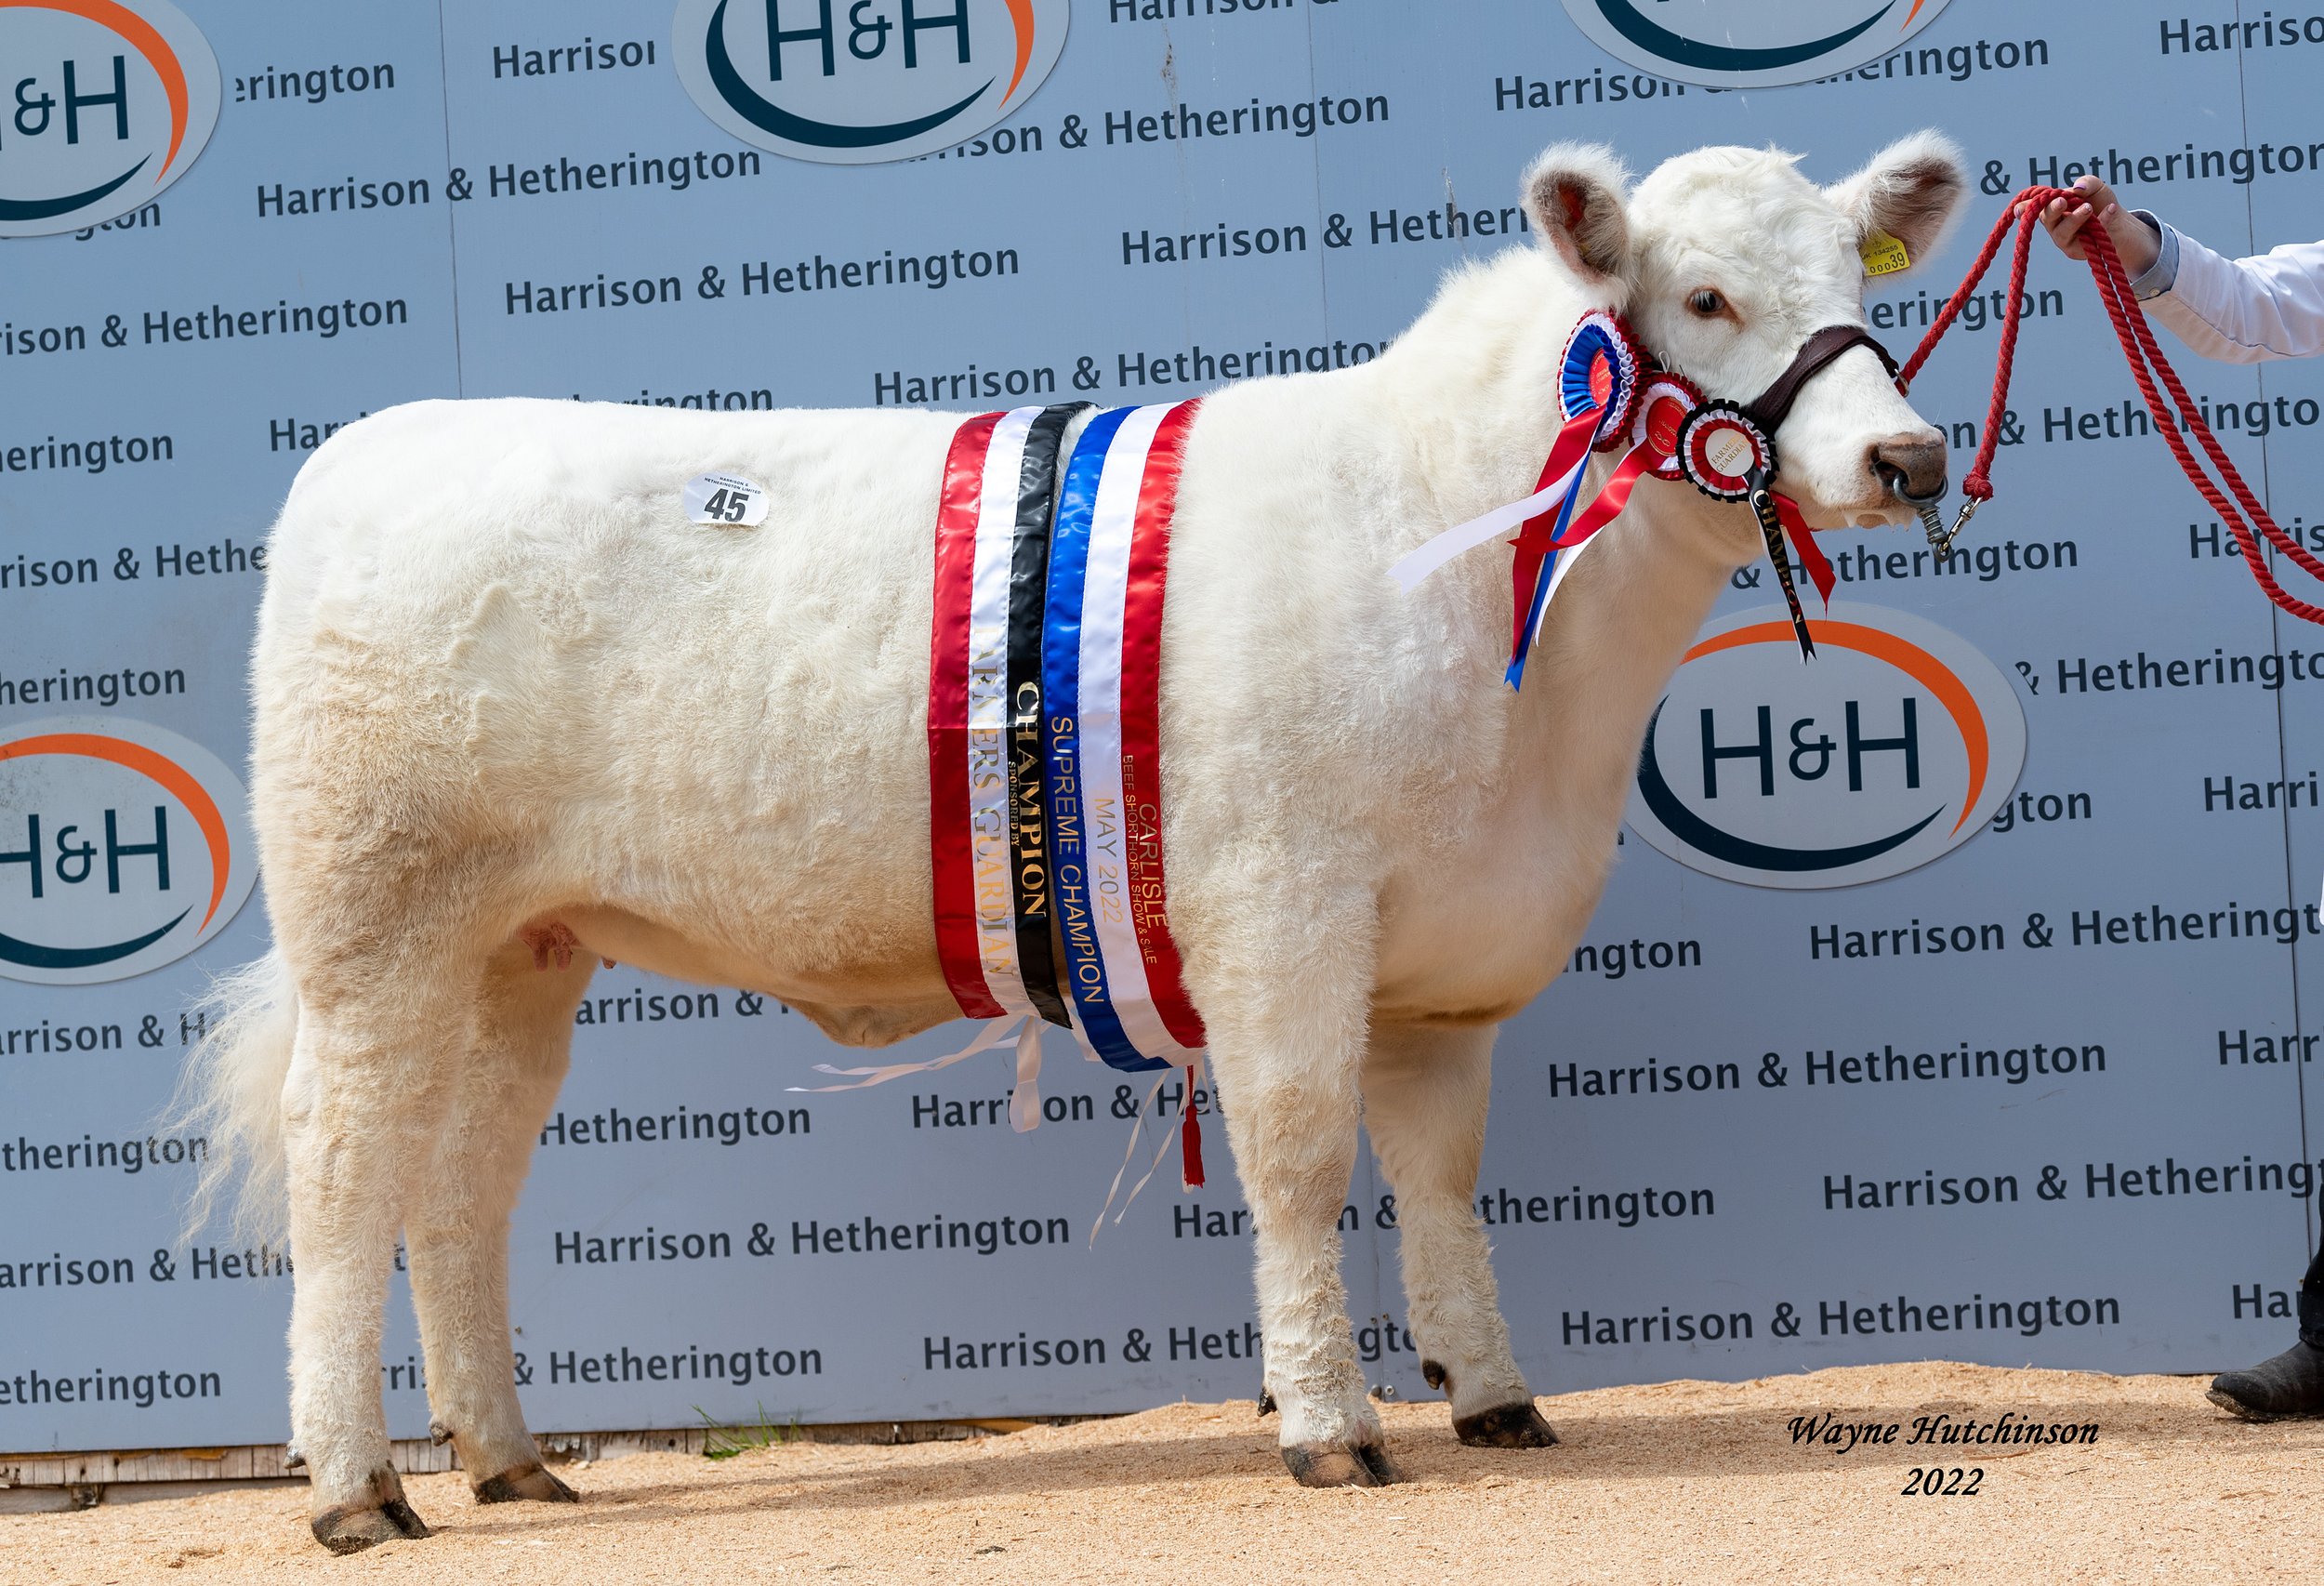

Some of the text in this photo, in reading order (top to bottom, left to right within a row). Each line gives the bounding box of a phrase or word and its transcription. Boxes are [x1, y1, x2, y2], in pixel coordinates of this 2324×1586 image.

[766, 0, 971, 82] H&H
[1059, 115, 1088, 148] &
[1105, 96, 1388, 144] Hetherington
[258, 152, 759, 217] Harrison & Hetherington
[1981, 160, 2011, 199] &
[1123, 226, 1305, 264] Harrison
[1324, 214, 1352, 247] &
[507, 247, 1018, 314] Harrison & Hetherington
[0, 298, 407, 357] ison & Hetherington
[875, 368, 1054, 404] Harrison
[1073, 356, 1101, 390] &
[704, 477, 761, 495] HETHERINGTON LIMITED
[704, 488, 749, 522] 45
[720, 477, 745, 486] HARRISON
[113, 548, 140, 580] &
[1753, 489, 1804, 624] CHAMPION
[1700, 697, 1921, 799] H&H
[1008, 761, 1021, 847] SPONSORED BY
[1015, 681, 1047, 918] CHAMPION
[1050, 716, 1104, 1003] SUPREME CHAMPION
[1093, 798, 1123, 924] MAY 2022
[1123, 755, 1157, 965] BEEF SHORTHORN SHOW & SALE
[1138, 803, 1169, 929] CARLISLE
[974, 806, 1014, 977] GUARDIAN
[1811, 922, 2005, 959] Harrison
[2023, 913, 2053, 948] &
[735, 989, 763, 1017] &
[0, 1019, 122, 1056] rrison
[138, 1015, 165, 1048] &
[1549, 1040, 2106, 1098] Harrison & Hetherington
[541, 1106, 811, 1147] Hetherington
[913, 1086, 1093, 1129] Harrion
[1111, 1085, 1141, 1119] &
[1472, 1187, 1715, 1228] therington
[1824, 1158, 2324, 1209] Harrison & Hethering
[556, 1212, 1070, 1264] Harrison & Hetherington
[150, 1249, 176, 1282] &
[1562, 1295, 2120, 1346] Harrison & Hetherington
[550, 1345, 822, 1386] Hetherington
[925, 1332, 1106, 1370] Harrison
[1123, 1328, 1152, 1363] &
